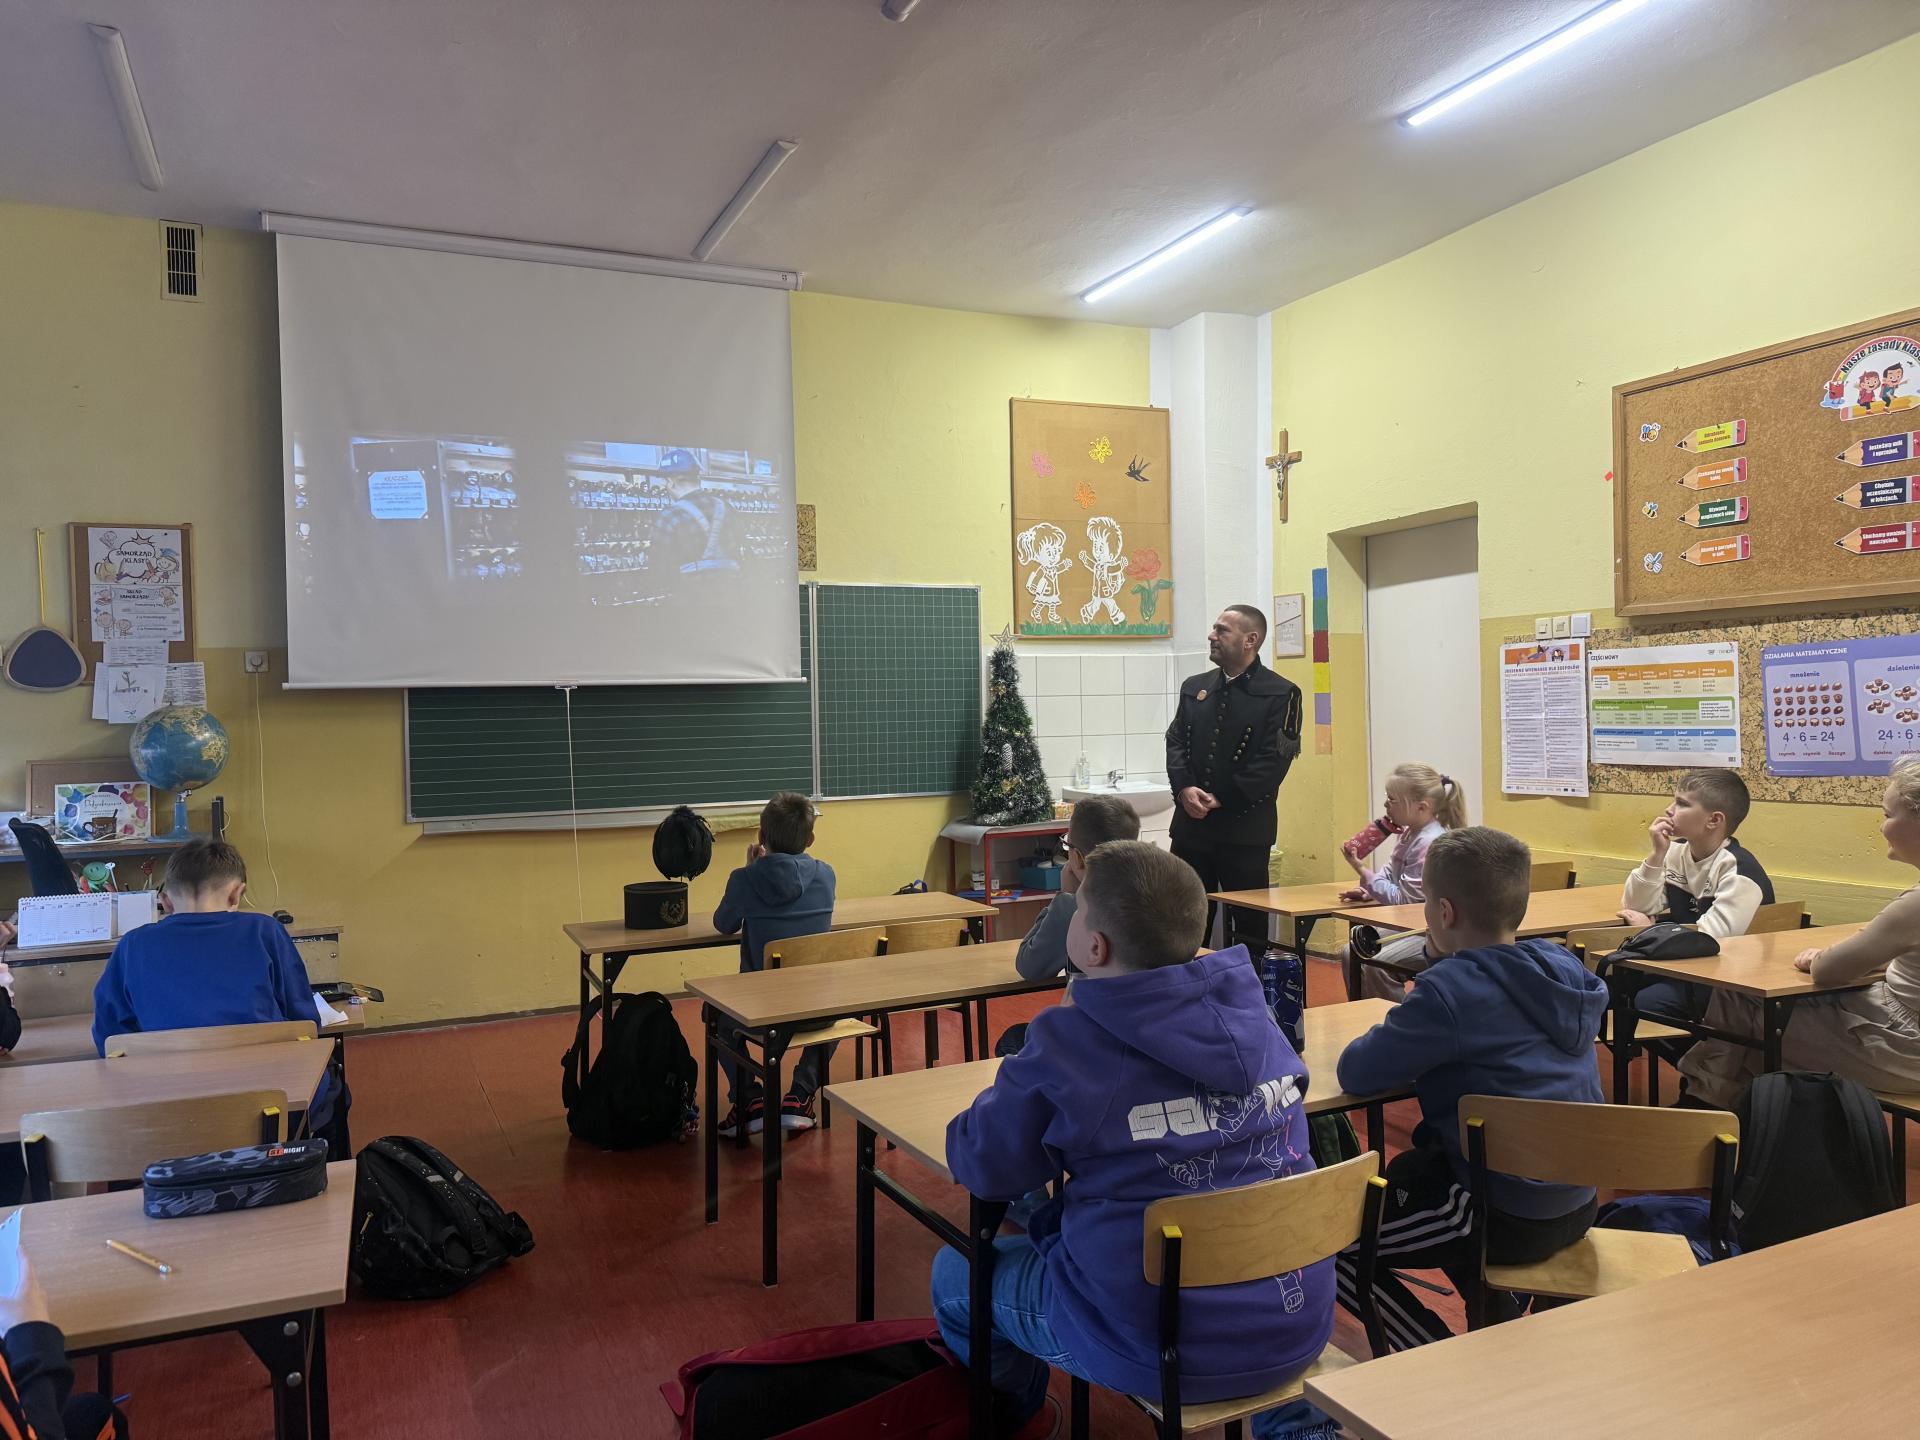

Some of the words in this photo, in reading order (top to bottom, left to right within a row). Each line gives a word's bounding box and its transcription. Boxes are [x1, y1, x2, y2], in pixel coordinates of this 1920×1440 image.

[1840, 349, 1866, 374] Nasze
[1867, 340, 1902, 353] zasady
[1796, 648, 1848, 657] MATEMATYCZNE
[1782, 733, 1789, 742] 4
[1800, 731, 1807, 742] 6
[1820, 731, 1835, 742] 24
[1878, 730, 1893, 740] 24
[1905, 729, 1913, 740] 6
